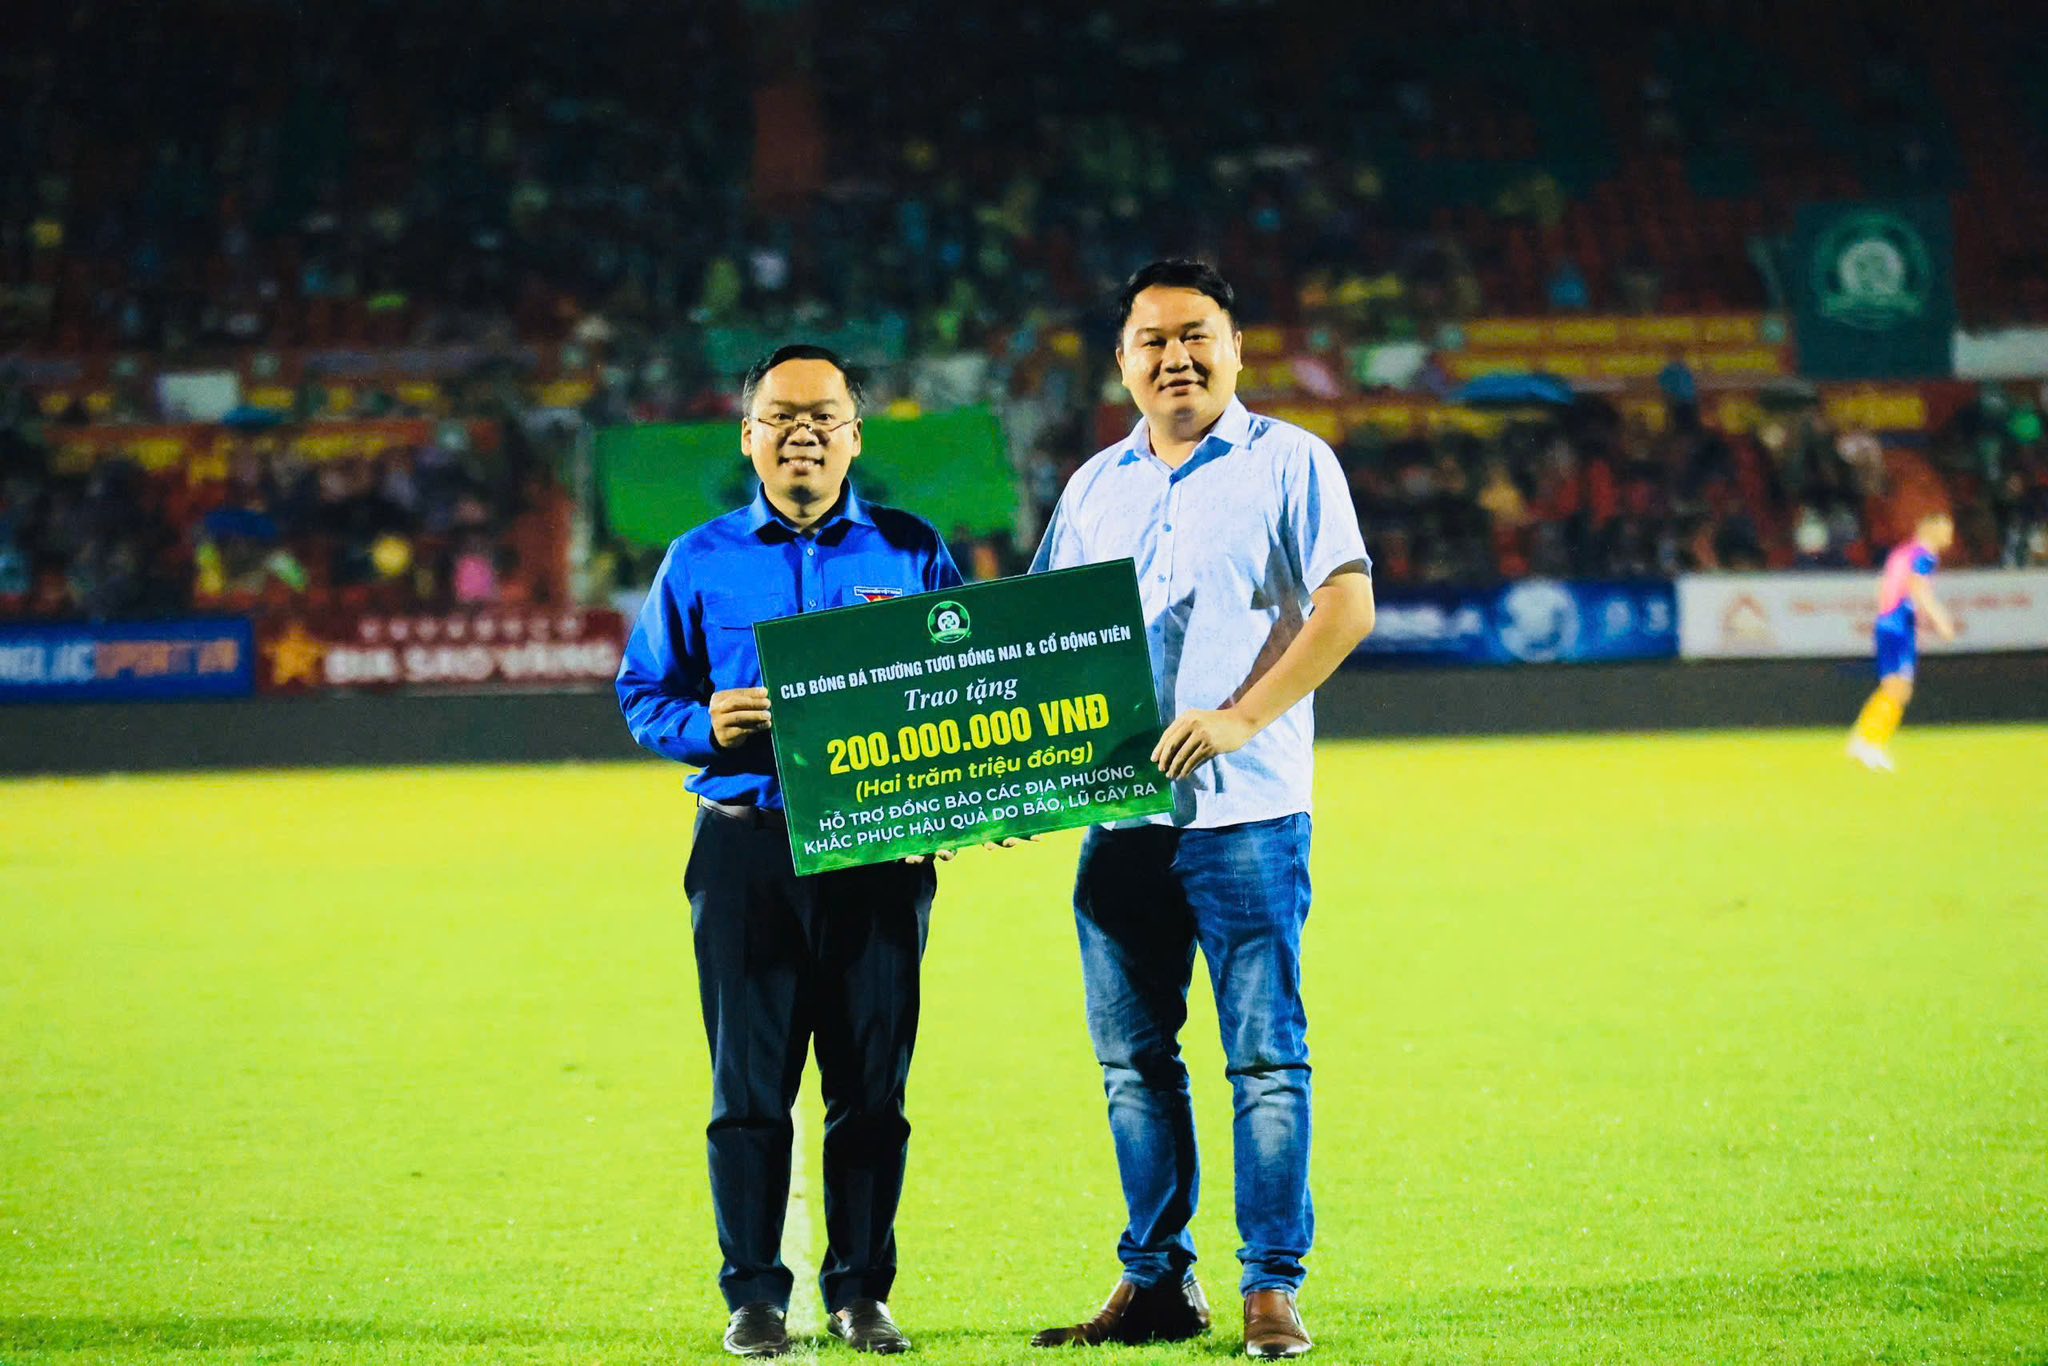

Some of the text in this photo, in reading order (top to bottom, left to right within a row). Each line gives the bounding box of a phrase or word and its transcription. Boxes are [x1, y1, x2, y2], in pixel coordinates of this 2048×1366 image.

[780, 682, 806, 699] CLB
[808, 676, 846, 694] BÓNG
[849, 668, 868, 687] ĐÁ
[869, 661, 923, 683] TRƯỜNG
[925, 654, 956, 673] TƯƠI
[997, 644, 1022, 661] NAI
[1025, 642, 1036, 656] &
[1039, 632, 1058, 654] CỔ
[1060, 631, 1097, 652] ĐỘNG
[1099, 624, 1131, 644] VIÊN
[904, 677, 1018, 711] Trao tặng
[826, 693, 1110, 775] 200.000.000 VNĐ
[819, 765, 1135, 831] HỖ TRỢ ĐỒNG BÀO CÁC ĐỊA PHƯƠNG
[855, 742, 1093, 802] (Hai trăm triệu đồng)
[804, 782, 1158, 855] KHẮC PHỤC HẬU QUẢ DO BÃO, LŨ GÂY RA
